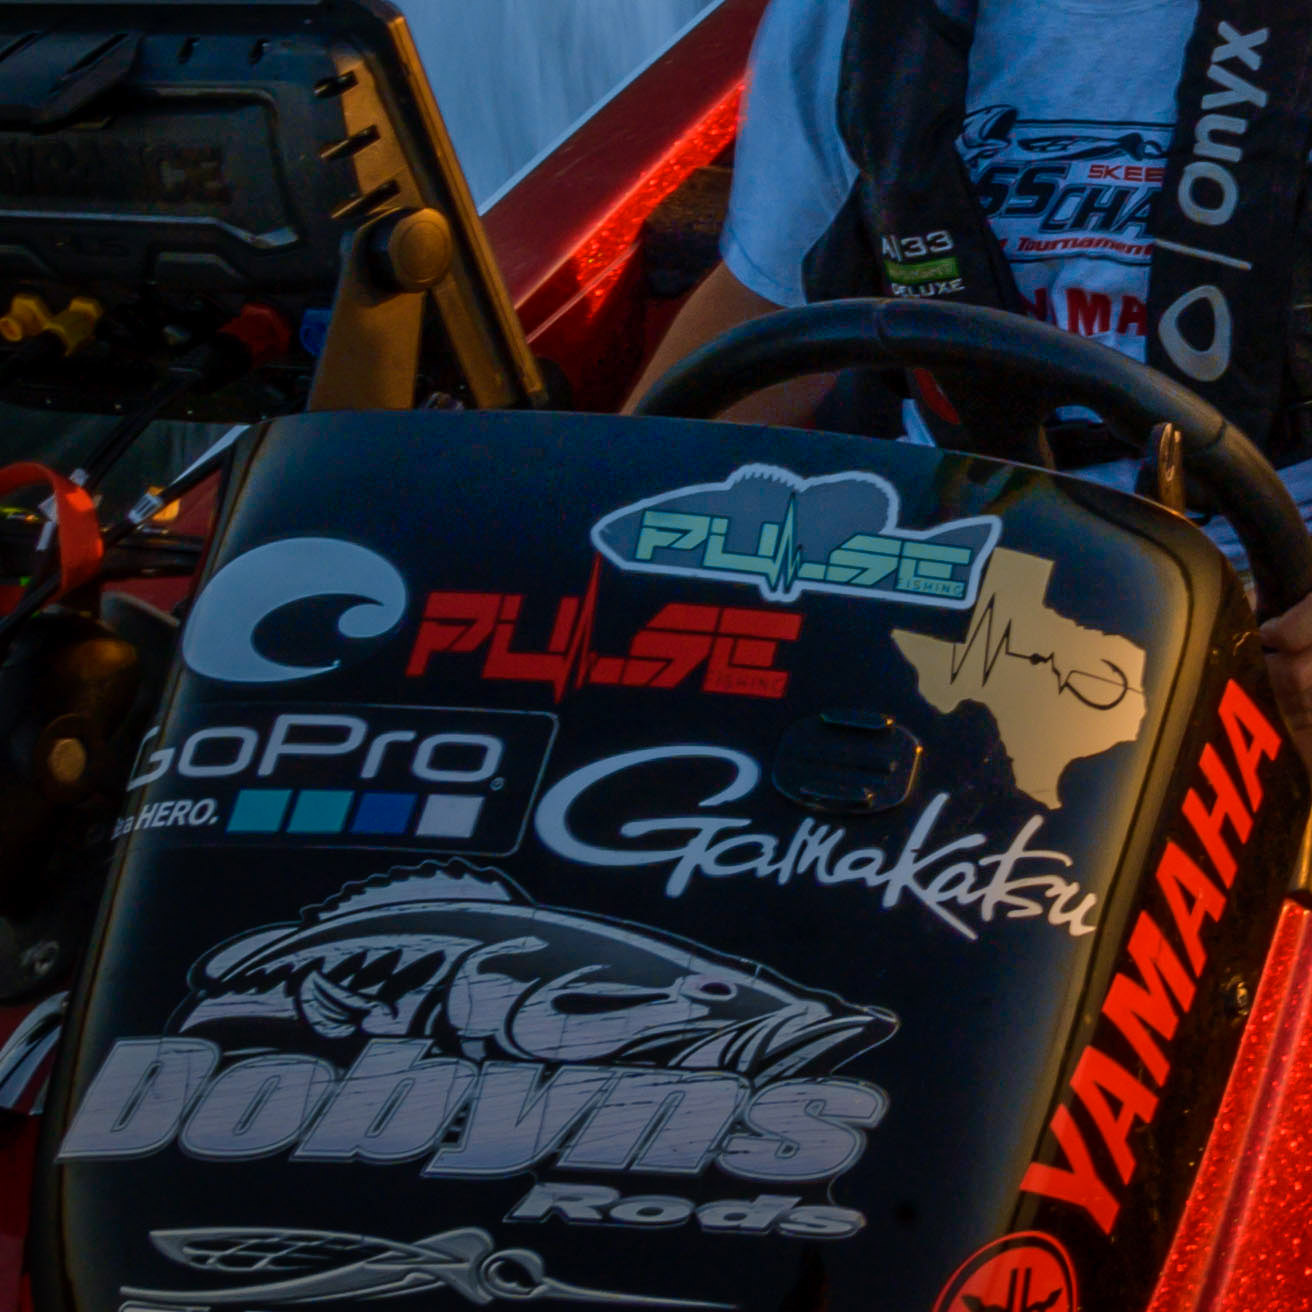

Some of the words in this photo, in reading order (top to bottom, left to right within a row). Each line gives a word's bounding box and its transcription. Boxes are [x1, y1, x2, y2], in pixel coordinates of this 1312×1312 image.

[1040, 183, 1158, 235] CHA
[1087, 163, 1168, 183] SKEE
[634, 492, 973, 599] PULSE
[405, 554, 807, 704] PULSE
[126, 714, 502, 793] GoPro
[1019, 679, 1283, 1236] YAMAHA
[56, 1036, 890, 1178] Dobyns
[503, 1181, 868, 1240] Rods
